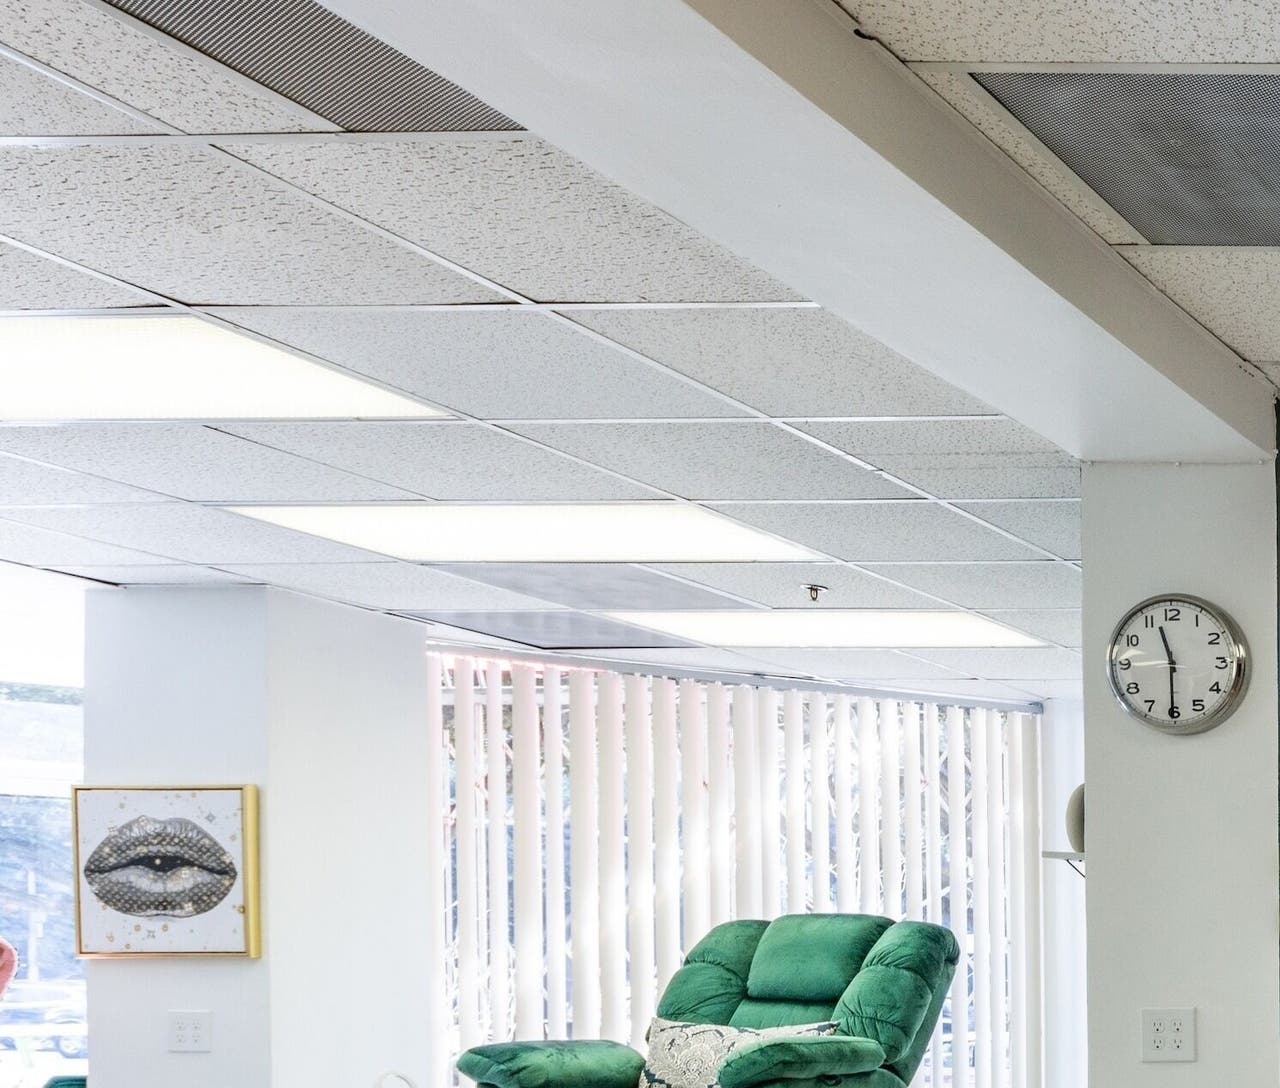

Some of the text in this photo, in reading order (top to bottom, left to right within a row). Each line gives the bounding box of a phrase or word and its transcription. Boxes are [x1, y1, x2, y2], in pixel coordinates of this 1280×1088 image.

[1145, 615, 1154, 628] 11
[1164, 608, 1180, 622] 12
[1195, 614, 1199, 627] 1
[1126, 634, 1139, 647] 10
[1208, 632, 1220, 645] 2
[1118, 658, 1132, 671] 9
[1215, 656, 1228, 670] 3
[1126, 682, 1140, 695] 8
[1208, 681, 1222, 694] 4
[1144, 699, 1155, 712] 7
[1192, 699, 1205, 712] 5
[1168, 706, 1181, 719] 6
